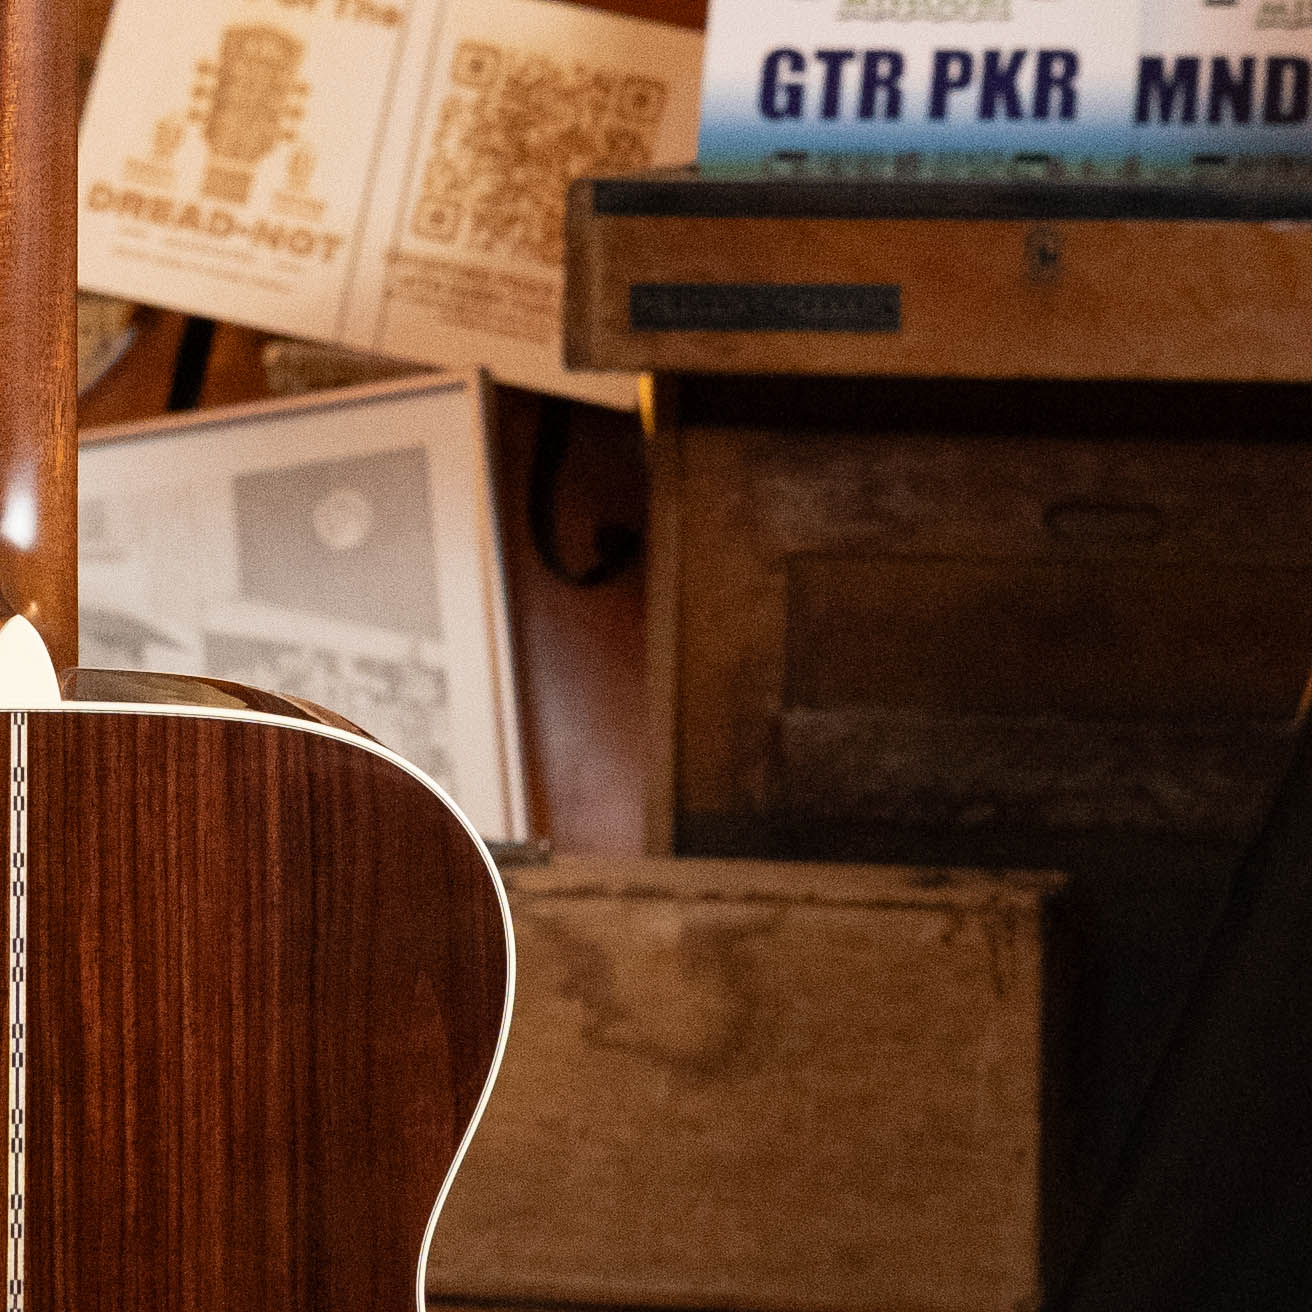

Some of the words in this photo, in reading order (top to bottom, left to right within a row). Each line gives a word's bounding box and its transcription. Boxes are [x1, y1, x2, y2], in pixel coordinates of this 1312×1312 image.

[758, 48, 905, 123] GTR
[928, 48, 1081, 123] PKR
[1133, 54, 1311, 126] MND
[86, 181, 346, 264] DREAD-NOT
